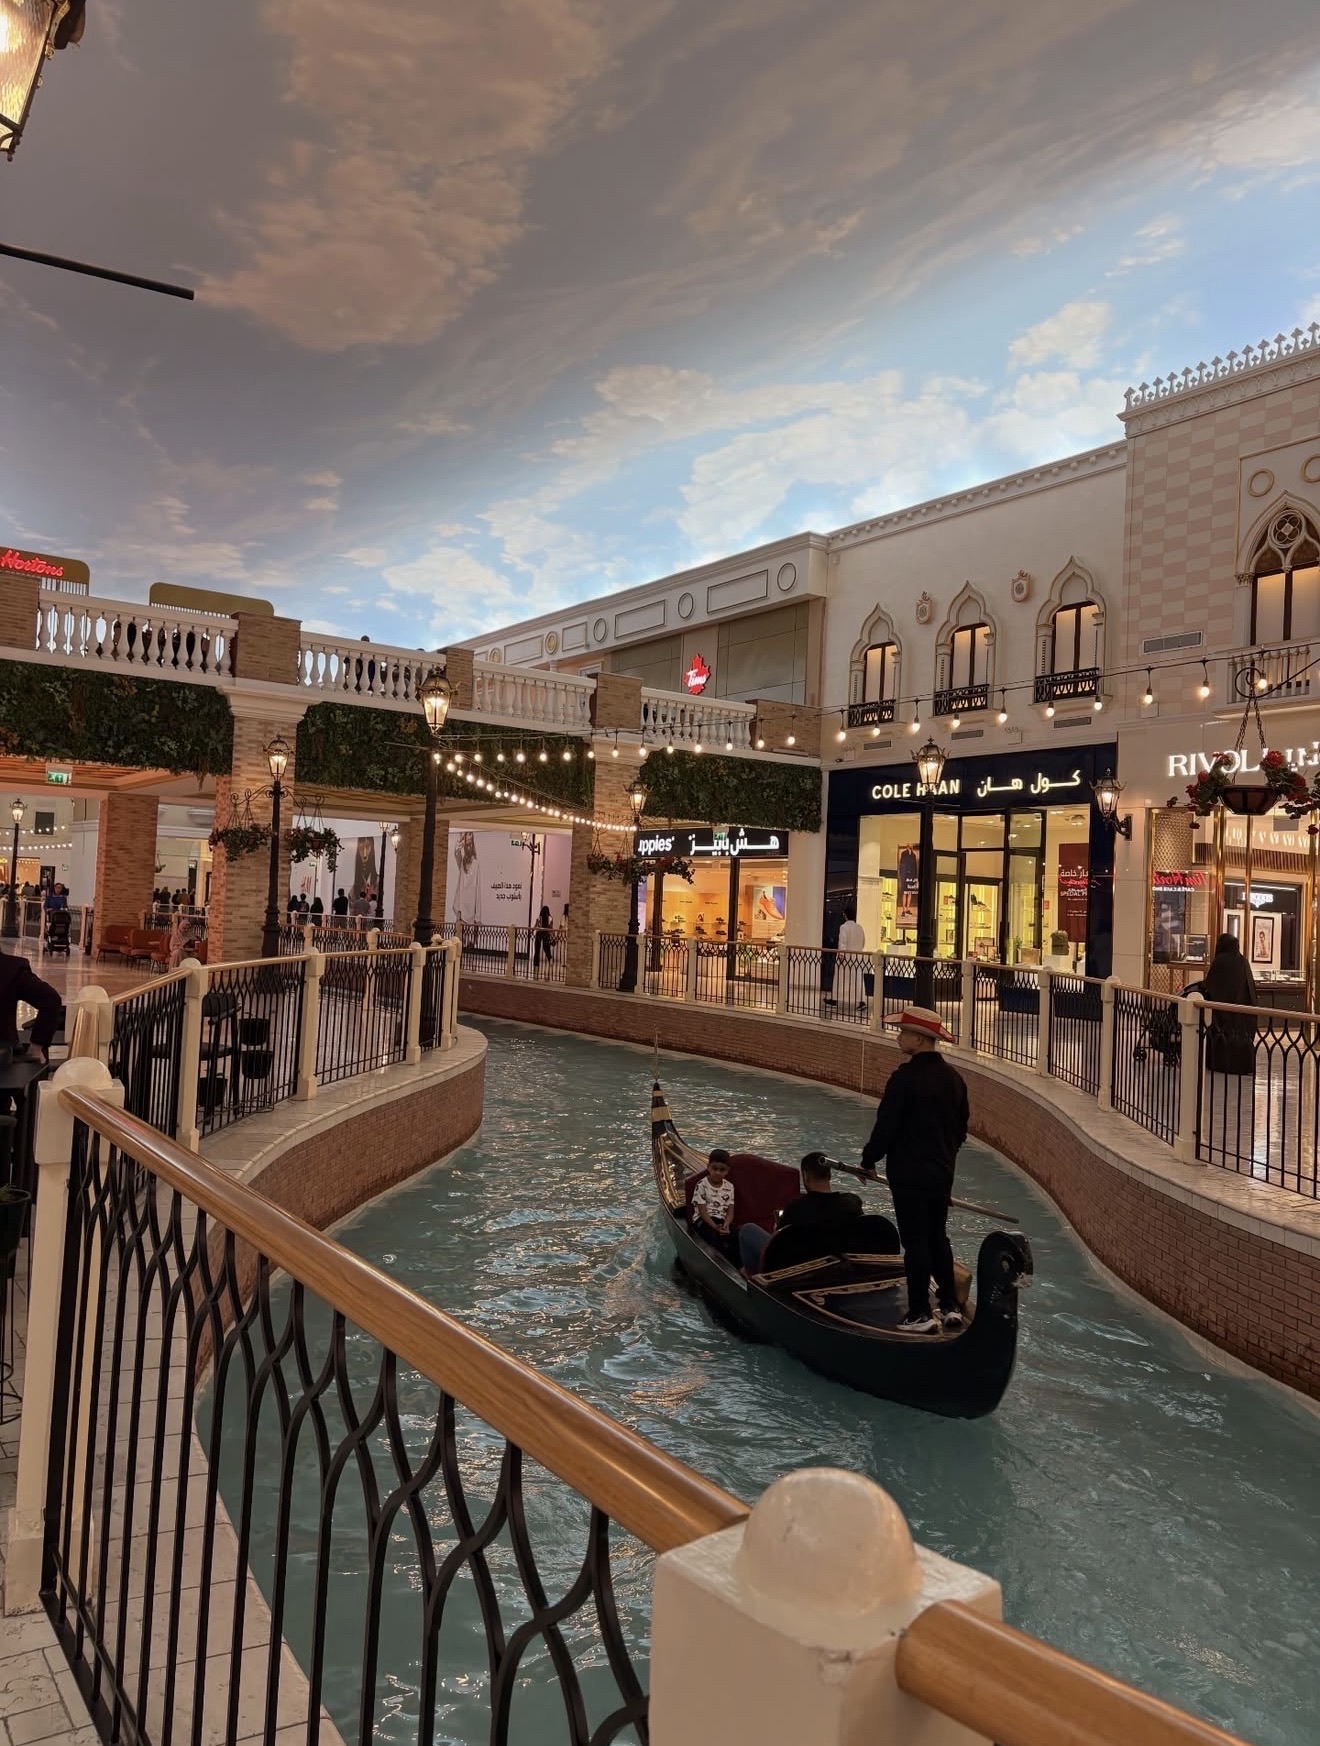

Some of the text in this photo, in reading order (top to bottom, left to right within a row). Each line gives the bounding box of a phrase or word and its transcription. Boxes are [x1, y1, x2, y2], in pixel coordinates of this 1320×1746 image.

[0, 549, 64, 577] Hortons
[871, 783, 911, 800] COLE
[976, 769, 1081, 798] كول هان
[730, 827, 780, 856] هش
